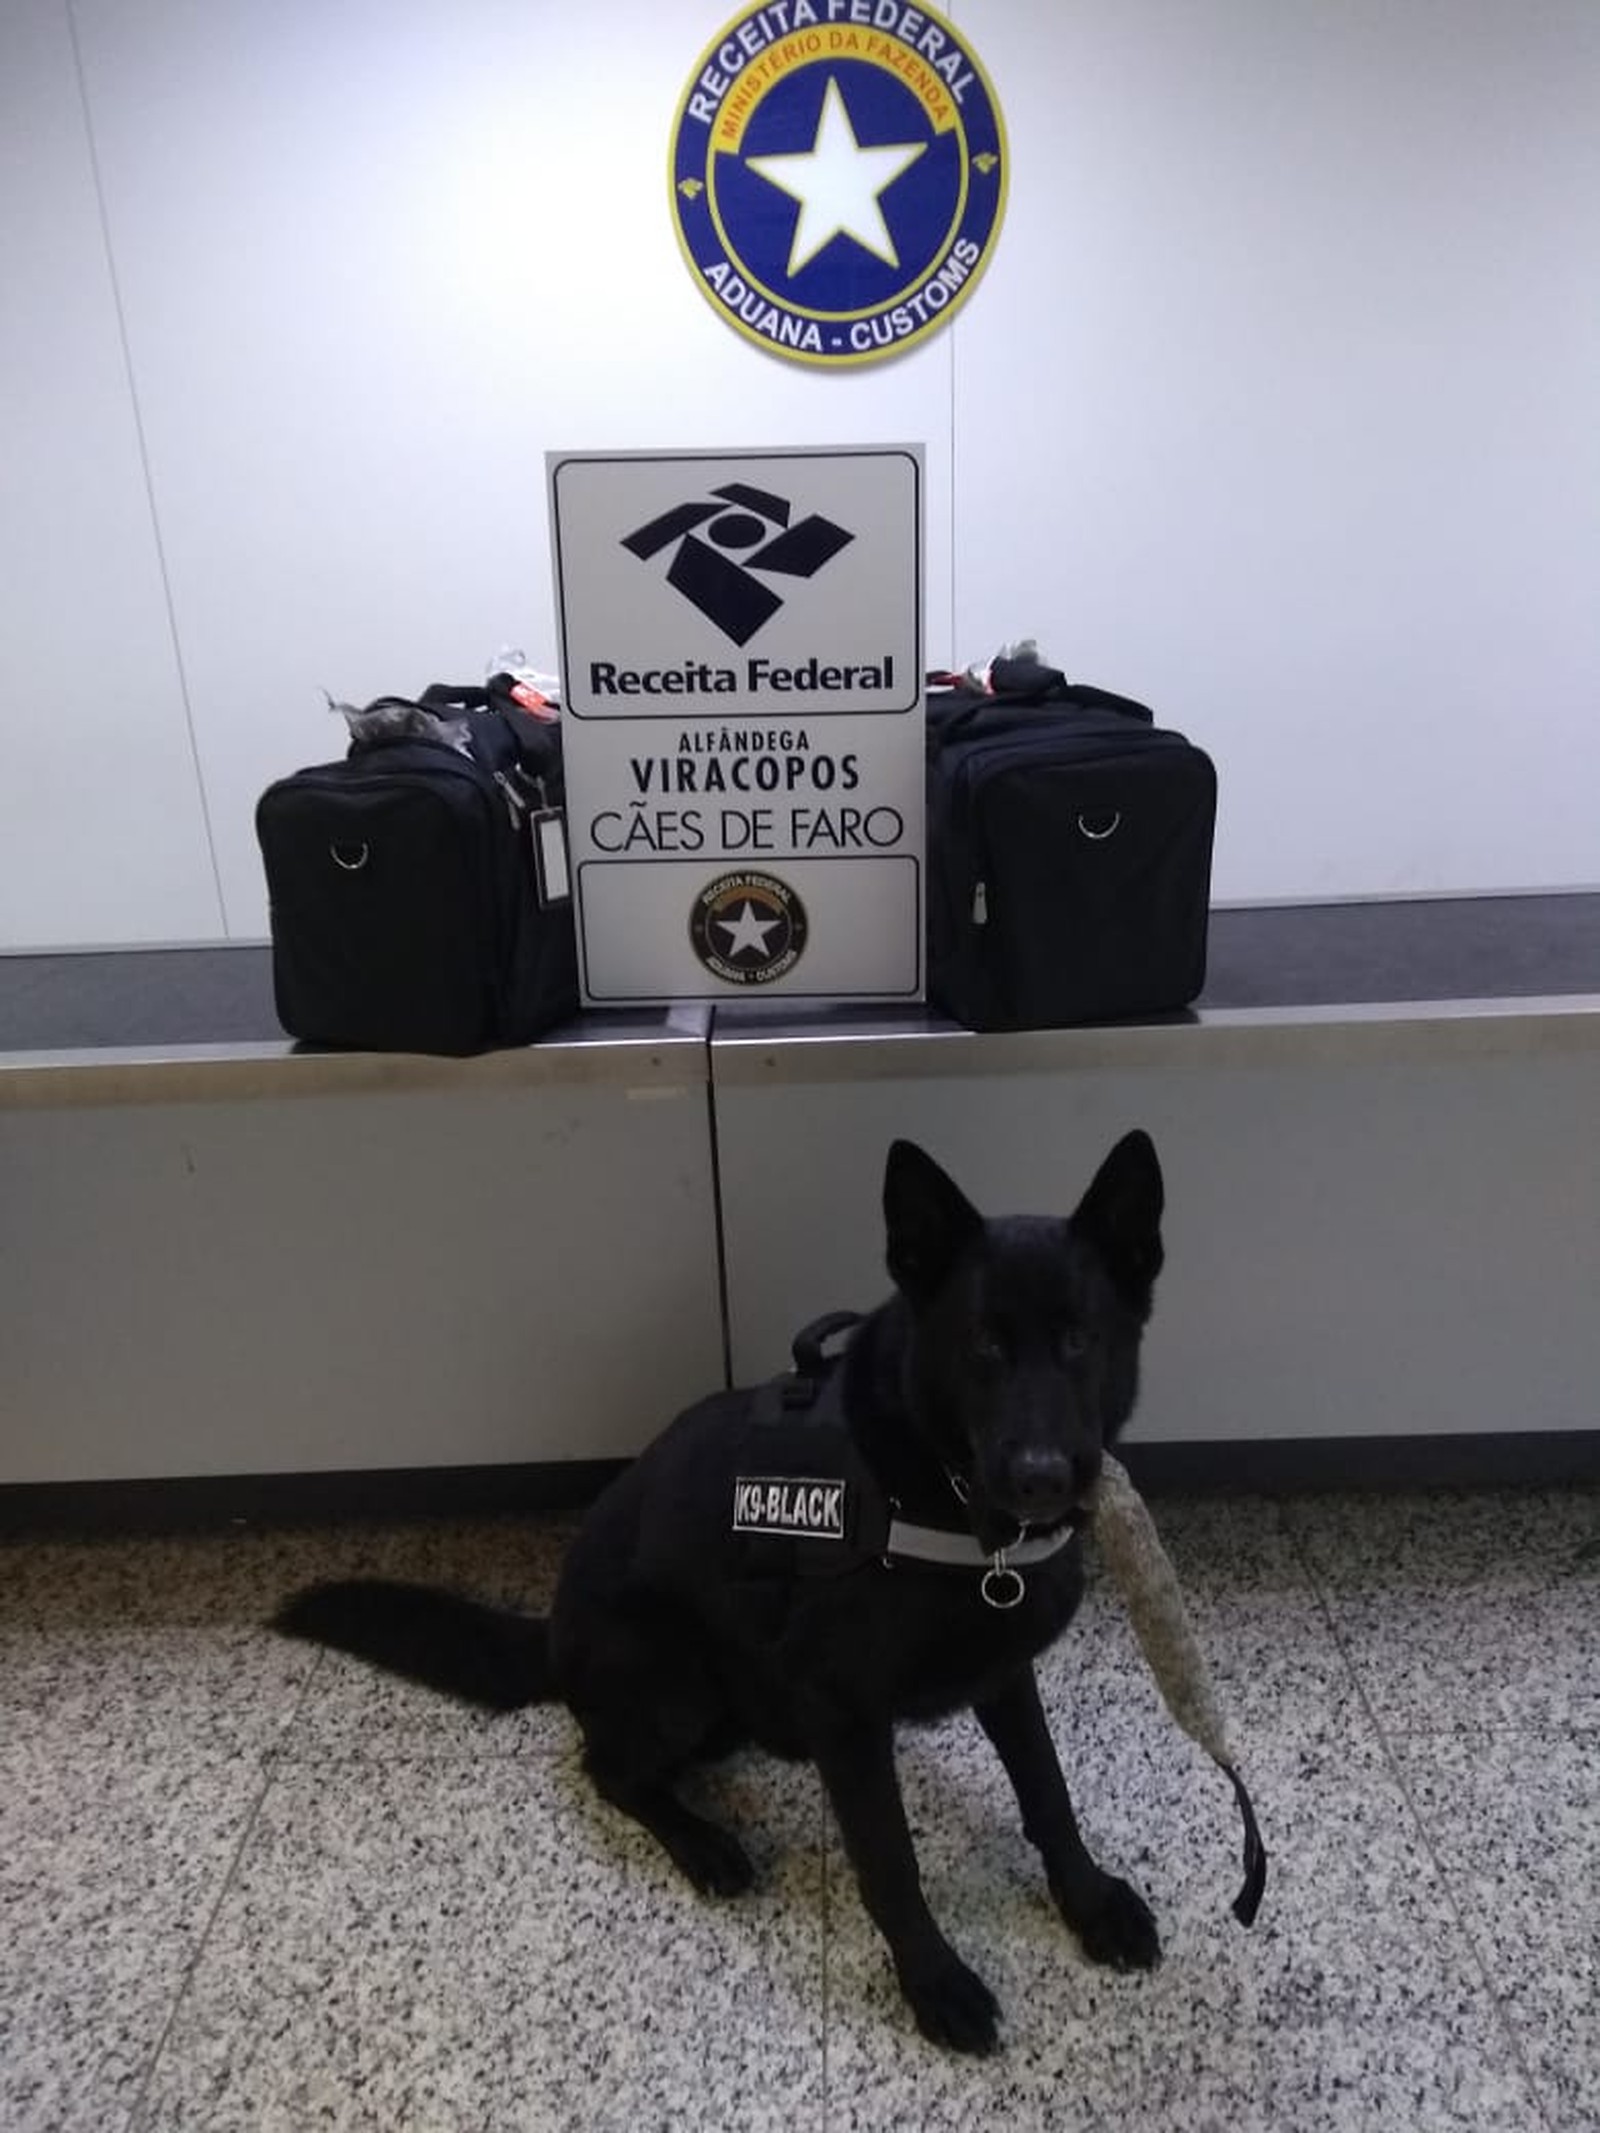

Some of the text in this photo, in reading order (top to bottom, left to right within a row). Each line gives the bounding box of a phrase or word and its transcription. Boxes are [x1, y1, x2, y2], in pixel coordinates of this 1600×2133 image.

[688, 0, 975, 123] RECEITA FEDERAL
[829, 31, 859, 50] DA
[866, 36, 949, 122] FAZENDA
[703, 262, 823, 351] ADUANA
[850, 238, 980, 351] CUSTOMS
[589, 656, 894, 695] Receita Federal
[679, 727, 810, 753] ALFÂNDEGA
[630, 755, 860, 793] VIRACOPOS
[590, 801, 904, 853] CÃES DE FARO
